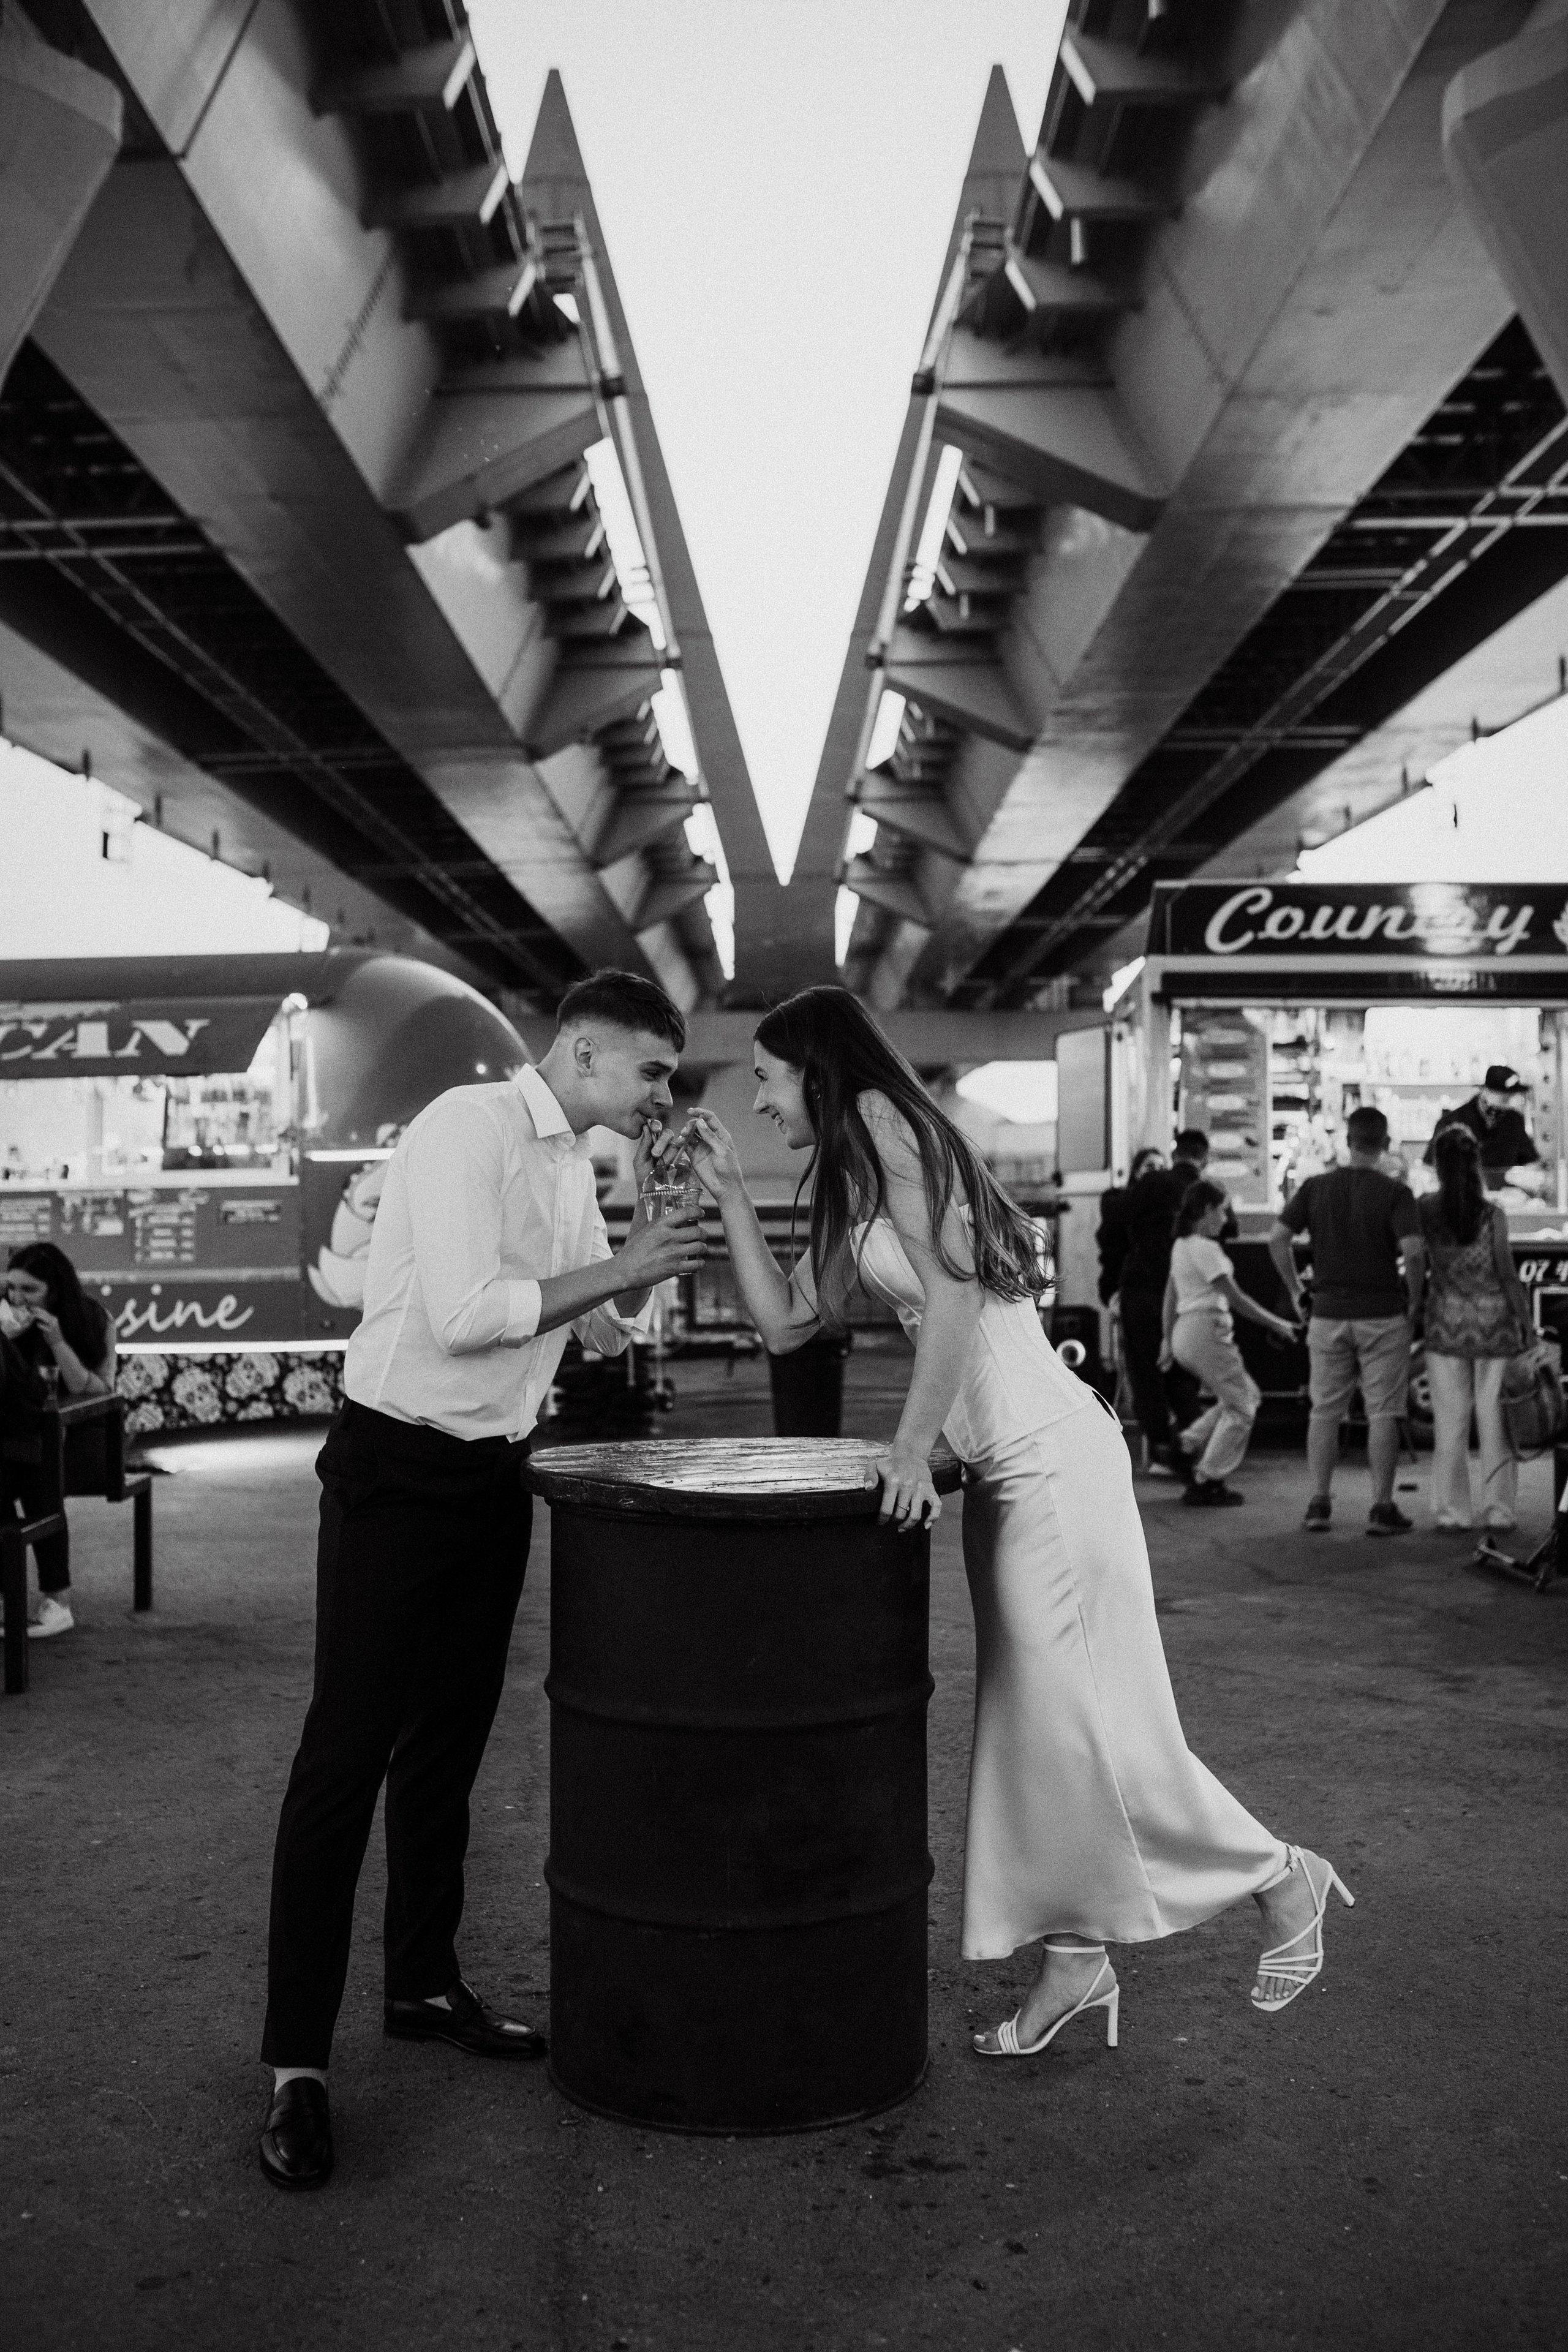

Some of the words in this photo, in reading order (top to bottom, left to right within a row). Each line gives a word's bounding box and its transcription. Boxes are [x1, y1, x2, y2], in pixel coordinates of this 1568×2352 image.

[1205, 886, 1534, 955] Couny
[0, 1018, 211, 1061] CAN
[1519, 1259, 1550, 1283] 07
[101, 1283, 254, 1338] sine
